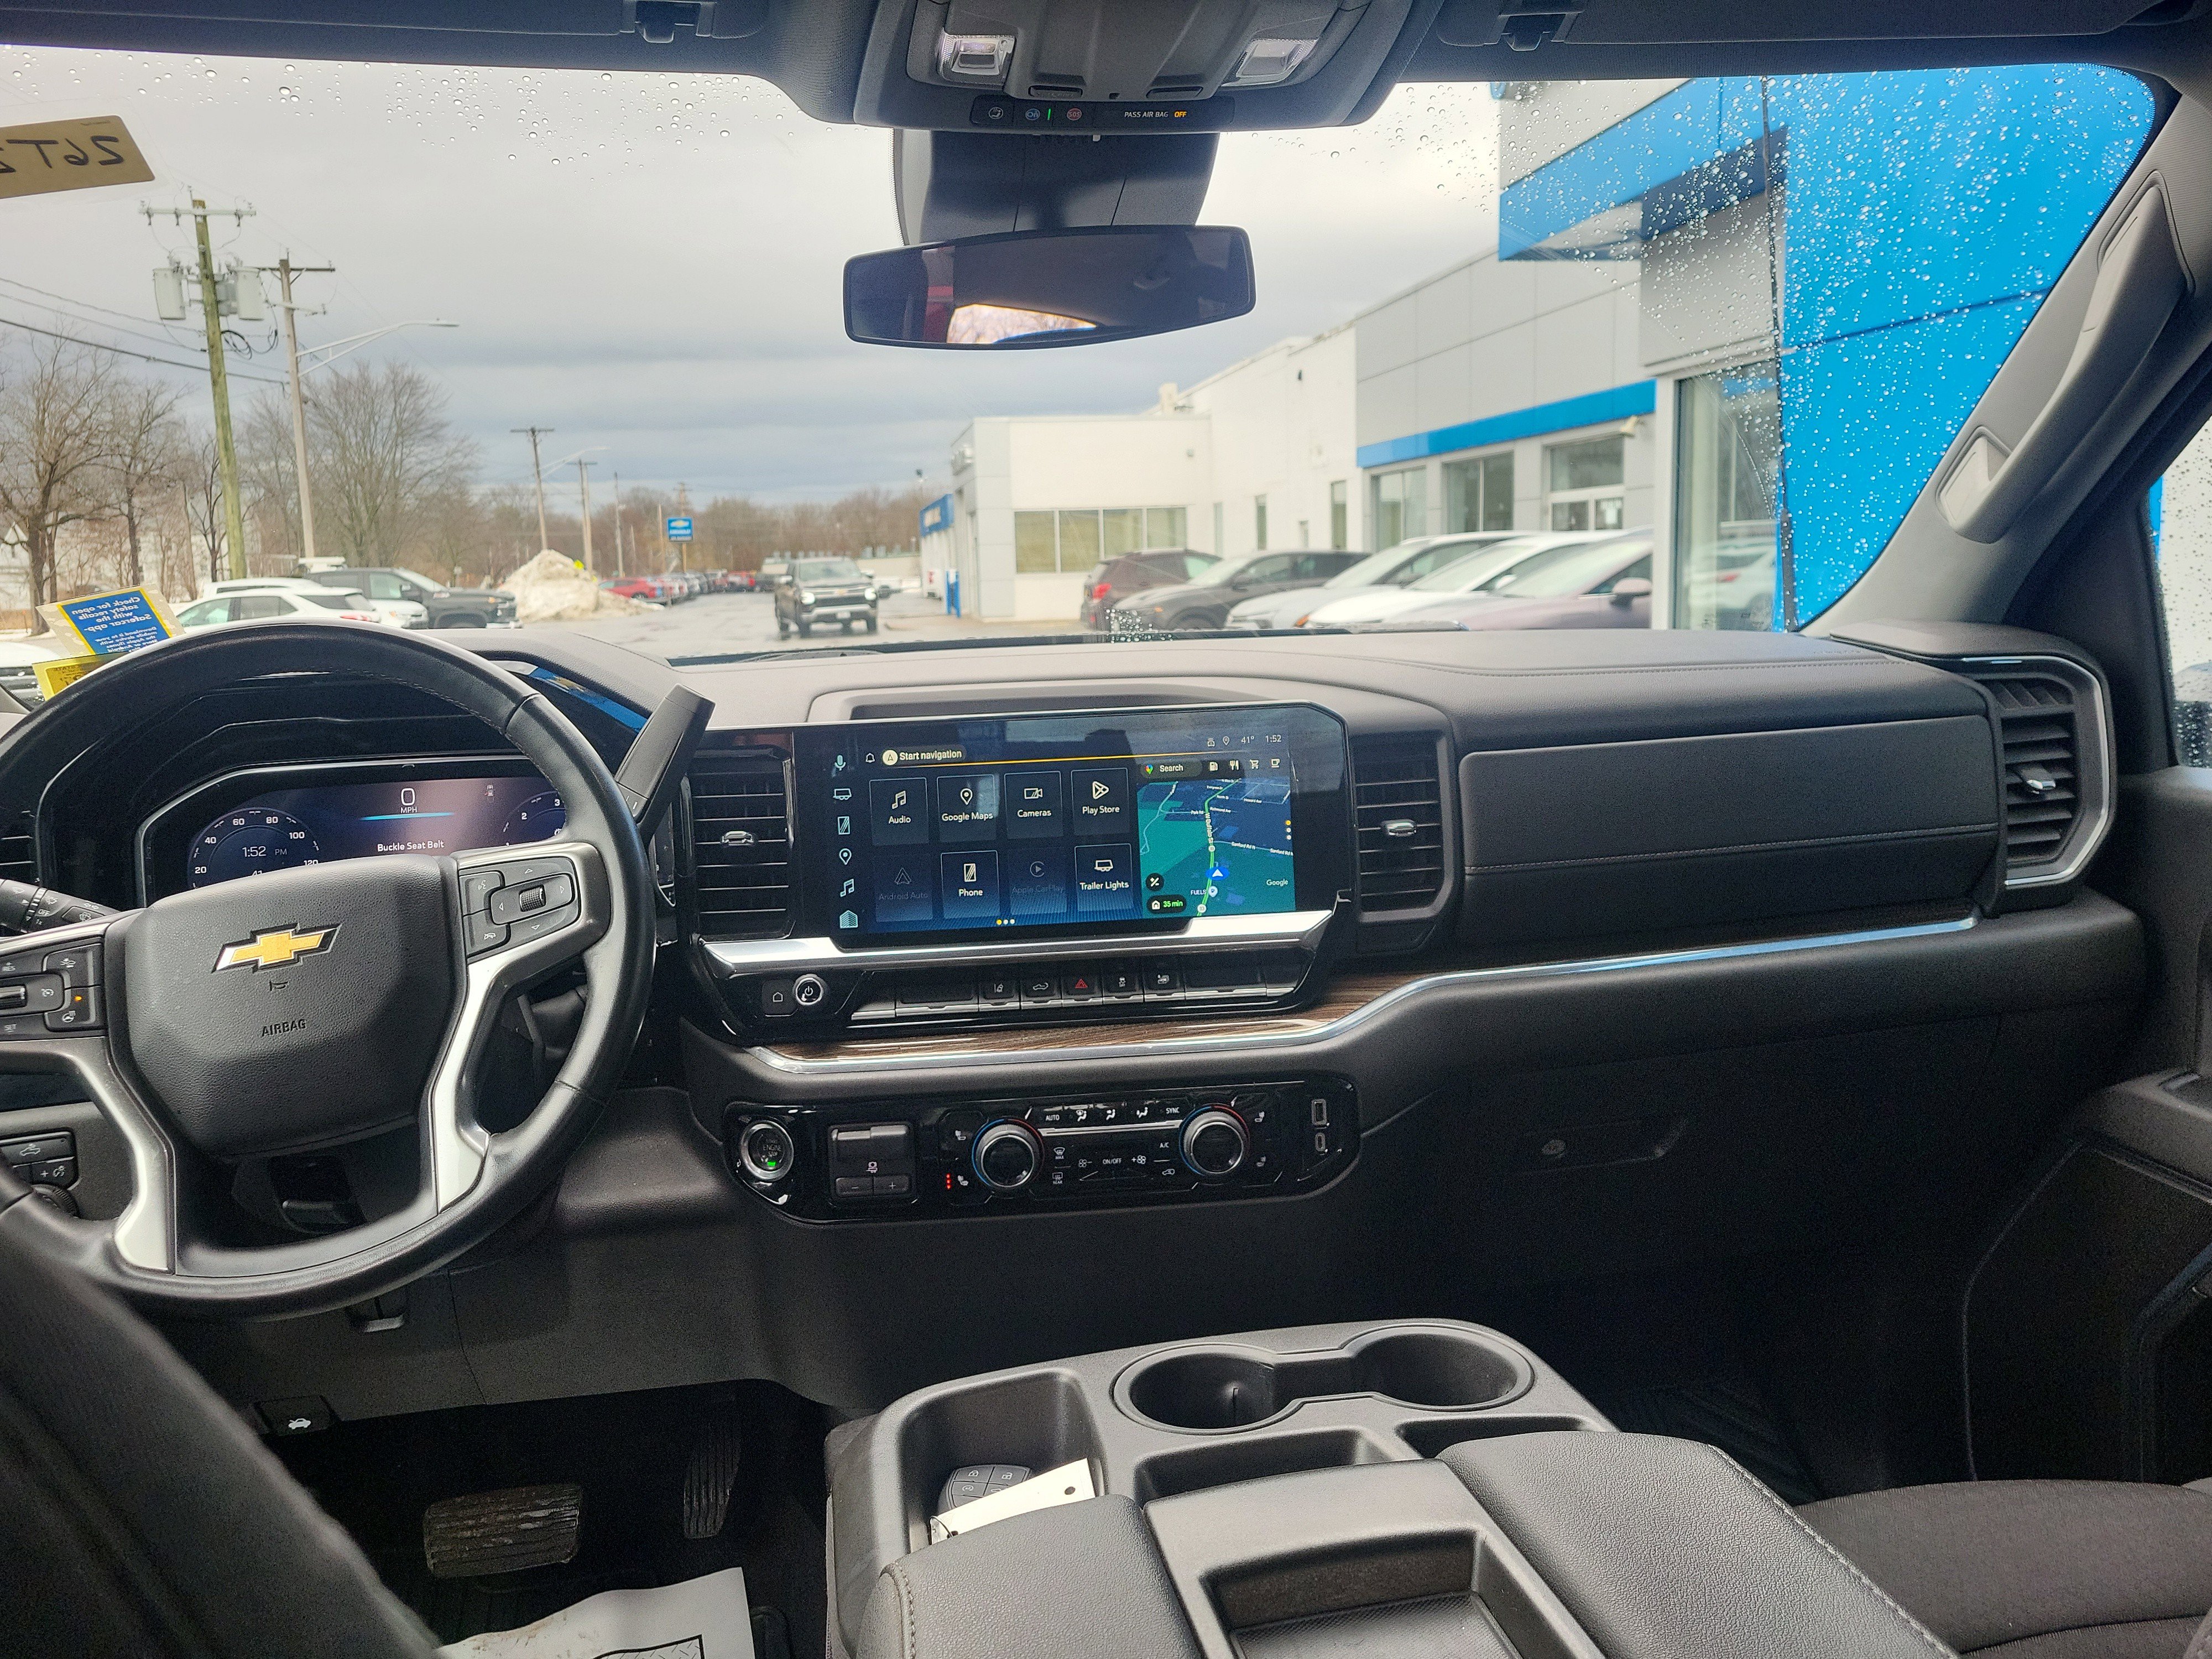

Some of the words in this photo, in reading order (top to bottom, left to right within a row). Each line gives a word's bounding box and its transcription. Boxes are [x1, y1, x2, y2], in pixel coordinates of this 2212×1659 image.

[1266, 734, 1281, 743] 1:52
[899, 752, 919, 760] Start
[921, 750, 962, 760] navigation
[401, 788, 415, 806] 0
[1018, 808, 1052, 817] Cameras
[1082, 805, 1100, 815] Play
[1101, 804, 1120, 813] Store
[888, 815, 911, 824] Audio
[942, 812, 969, 822] Google
[971, 811, 993, 821] Maps
[289, 831, 305, 839] 100
[377, 842, 405, 852] Buckle
[427, 839, 445, 848] Belt
[242, 846, 267, 857] 1:52
[1079, 882, 1104, 891] Trailer
[1105, 880, 1129, 891] Lights
[879, 892, 909, 901] Android
[958, 888, 983, 897] Phone
[261, 1019, 306, 1037] AIRBAG
